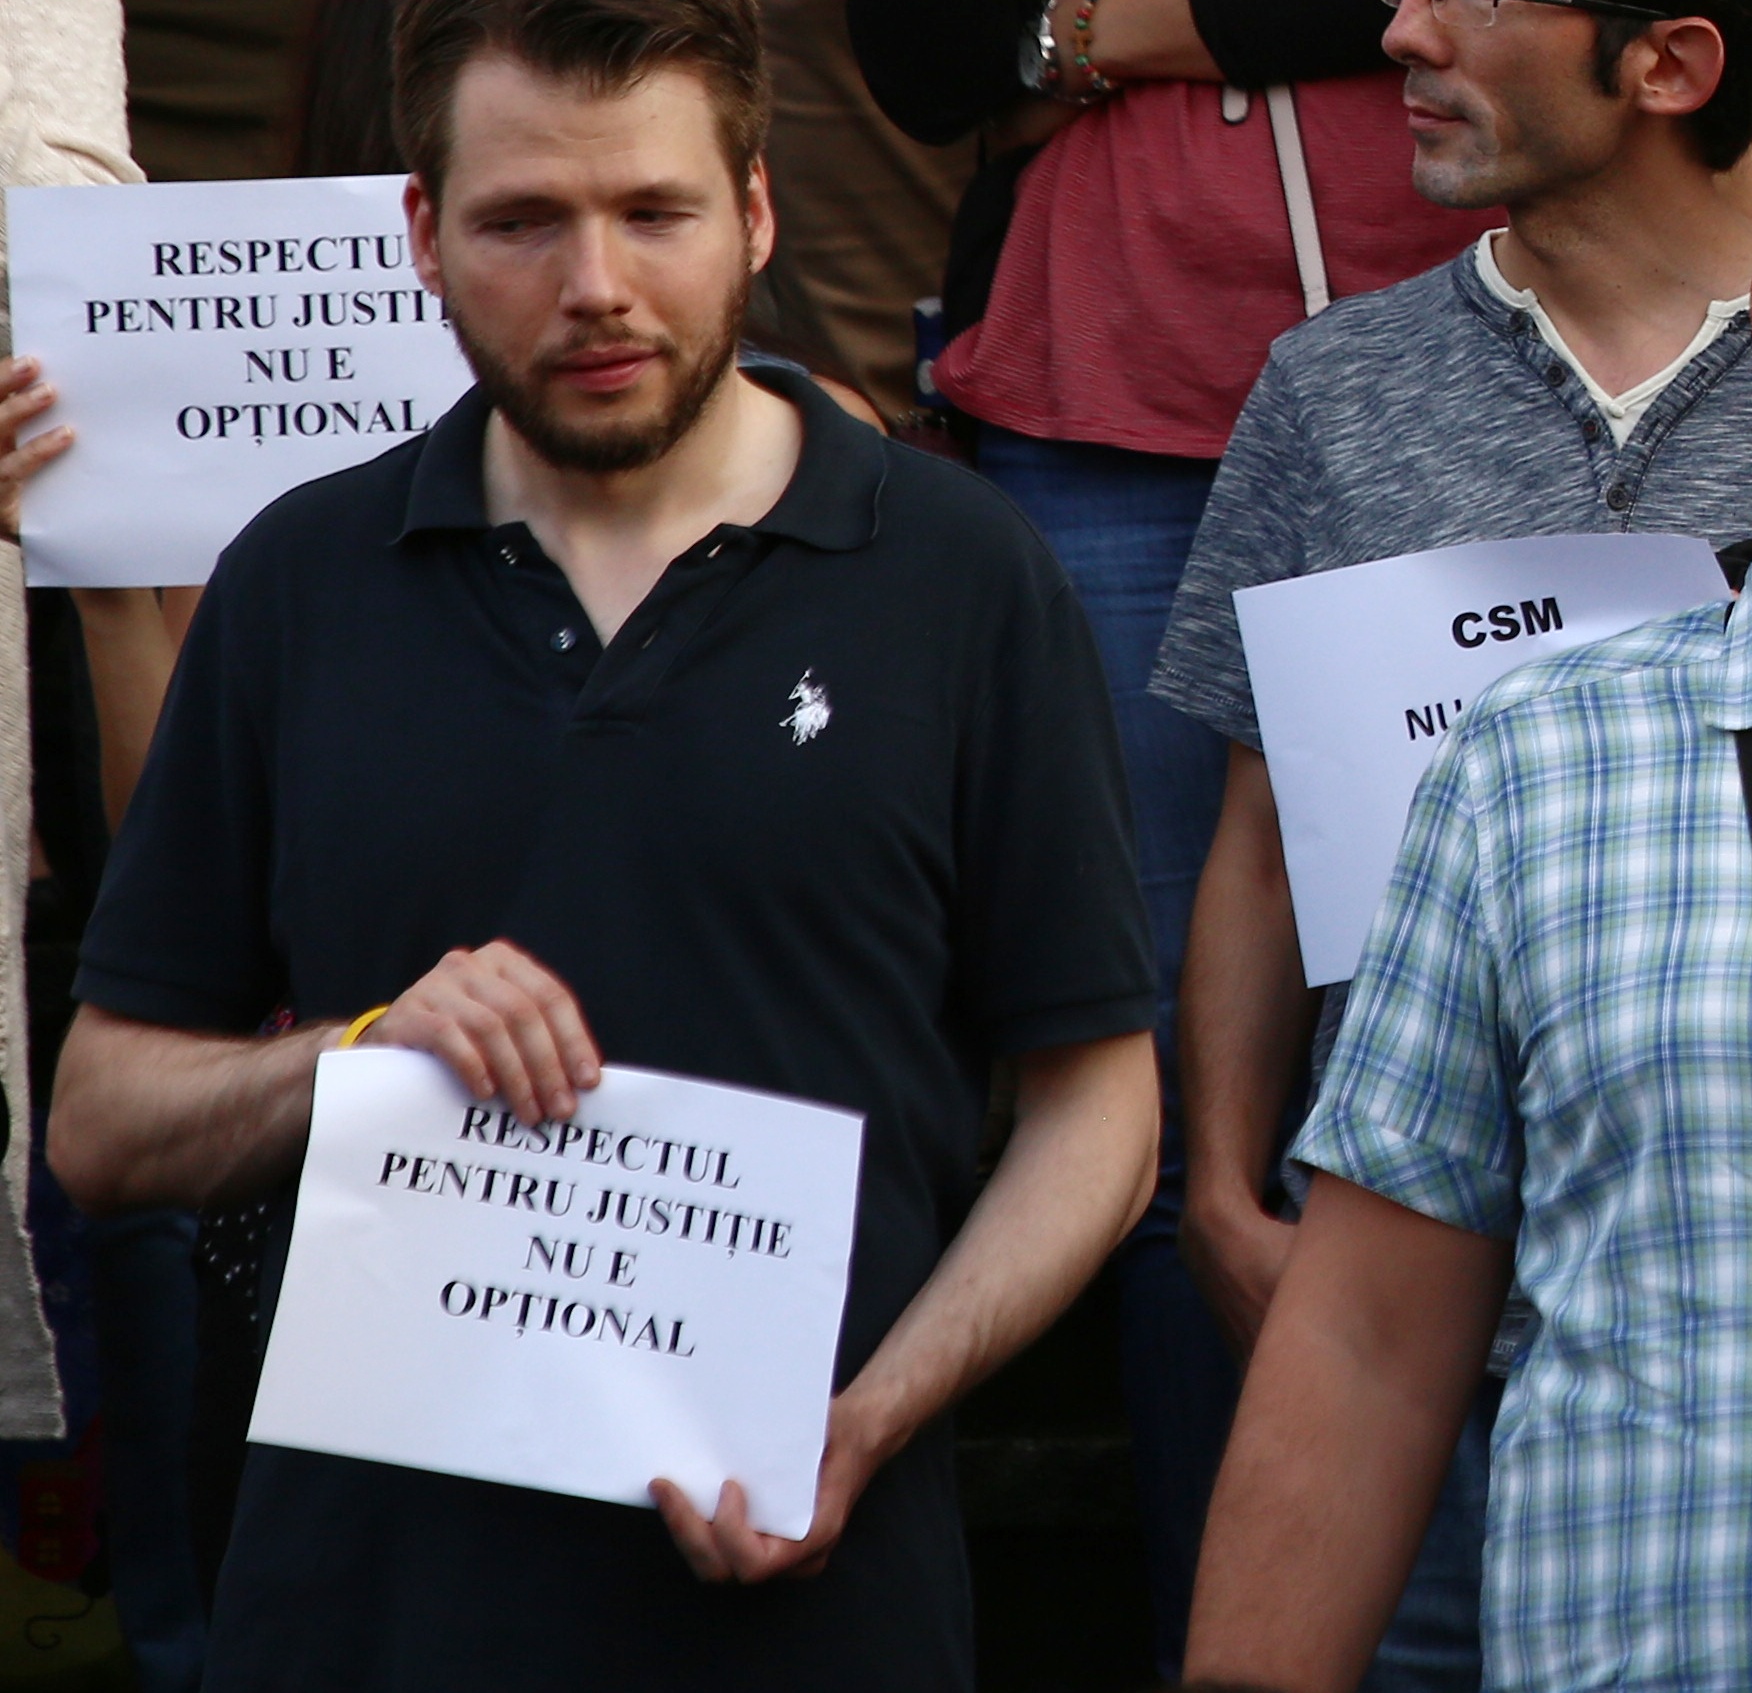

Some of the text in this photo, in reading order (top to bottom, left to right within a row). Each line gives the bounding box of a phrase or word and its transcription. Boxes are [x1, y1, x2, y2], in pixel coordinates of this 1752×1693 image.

[152, 234, 416, 278] RESPECTU
[85, 295, 277, 333] PENTRU
[244, 347, 355, 383] NU E
[176, 398, 432, 447] OPȚIONAL
[1452, 597, 1563, 648] CSM
[458, 1105, 741, 1190] RESPECTUL
[378, 1152, 791, 1261] PENTRU JUSTIȚIE
[525, 1234, 637, 1287] NU E
[440, 1278, 695, 1357] OPȚIONAL
